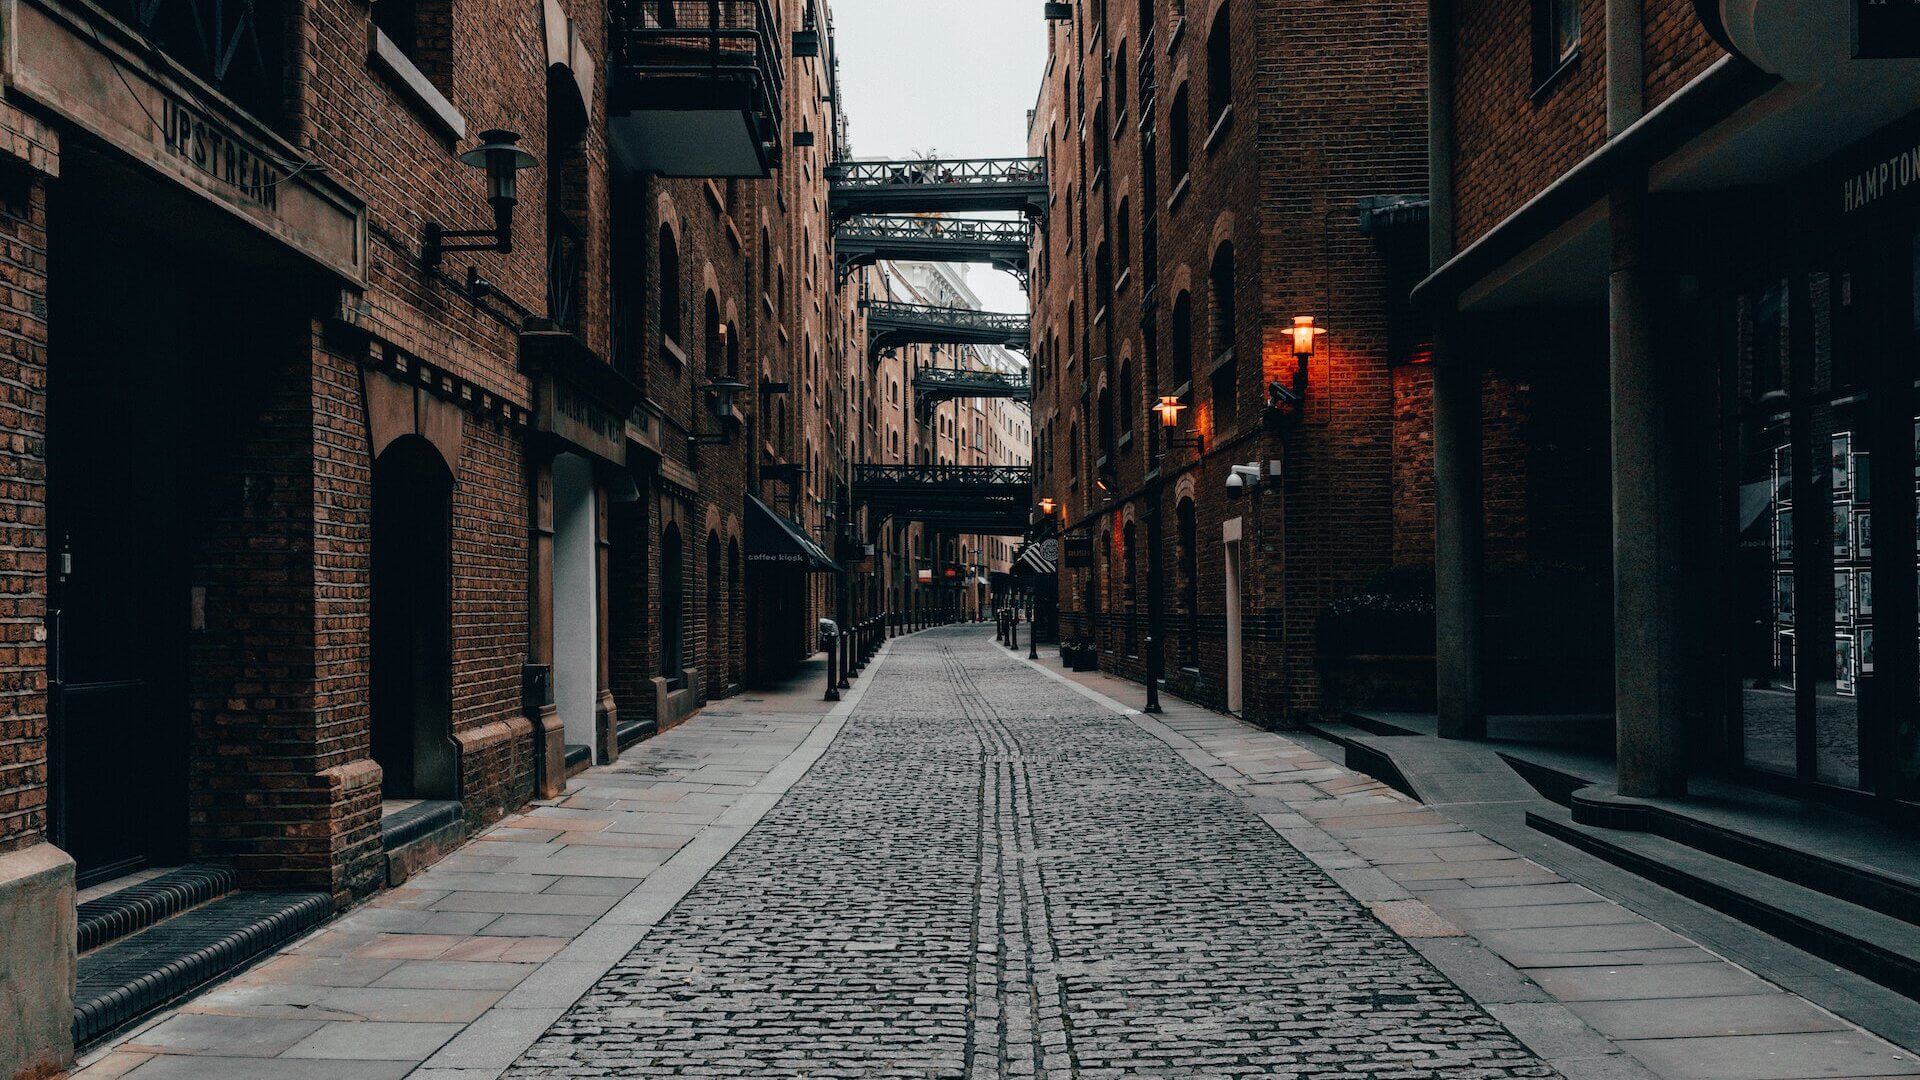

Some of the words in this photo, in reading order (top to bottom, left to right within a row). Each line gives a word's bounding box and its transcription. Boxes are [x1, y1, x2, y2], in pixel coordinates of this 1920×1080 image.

[163, 97, 277, 211] UPSTREAM
[1844, 145, 1920, 213] HAMPTON
[747, 552, 777, 561] coffee
[779, 552, 804, 562] kiosk
